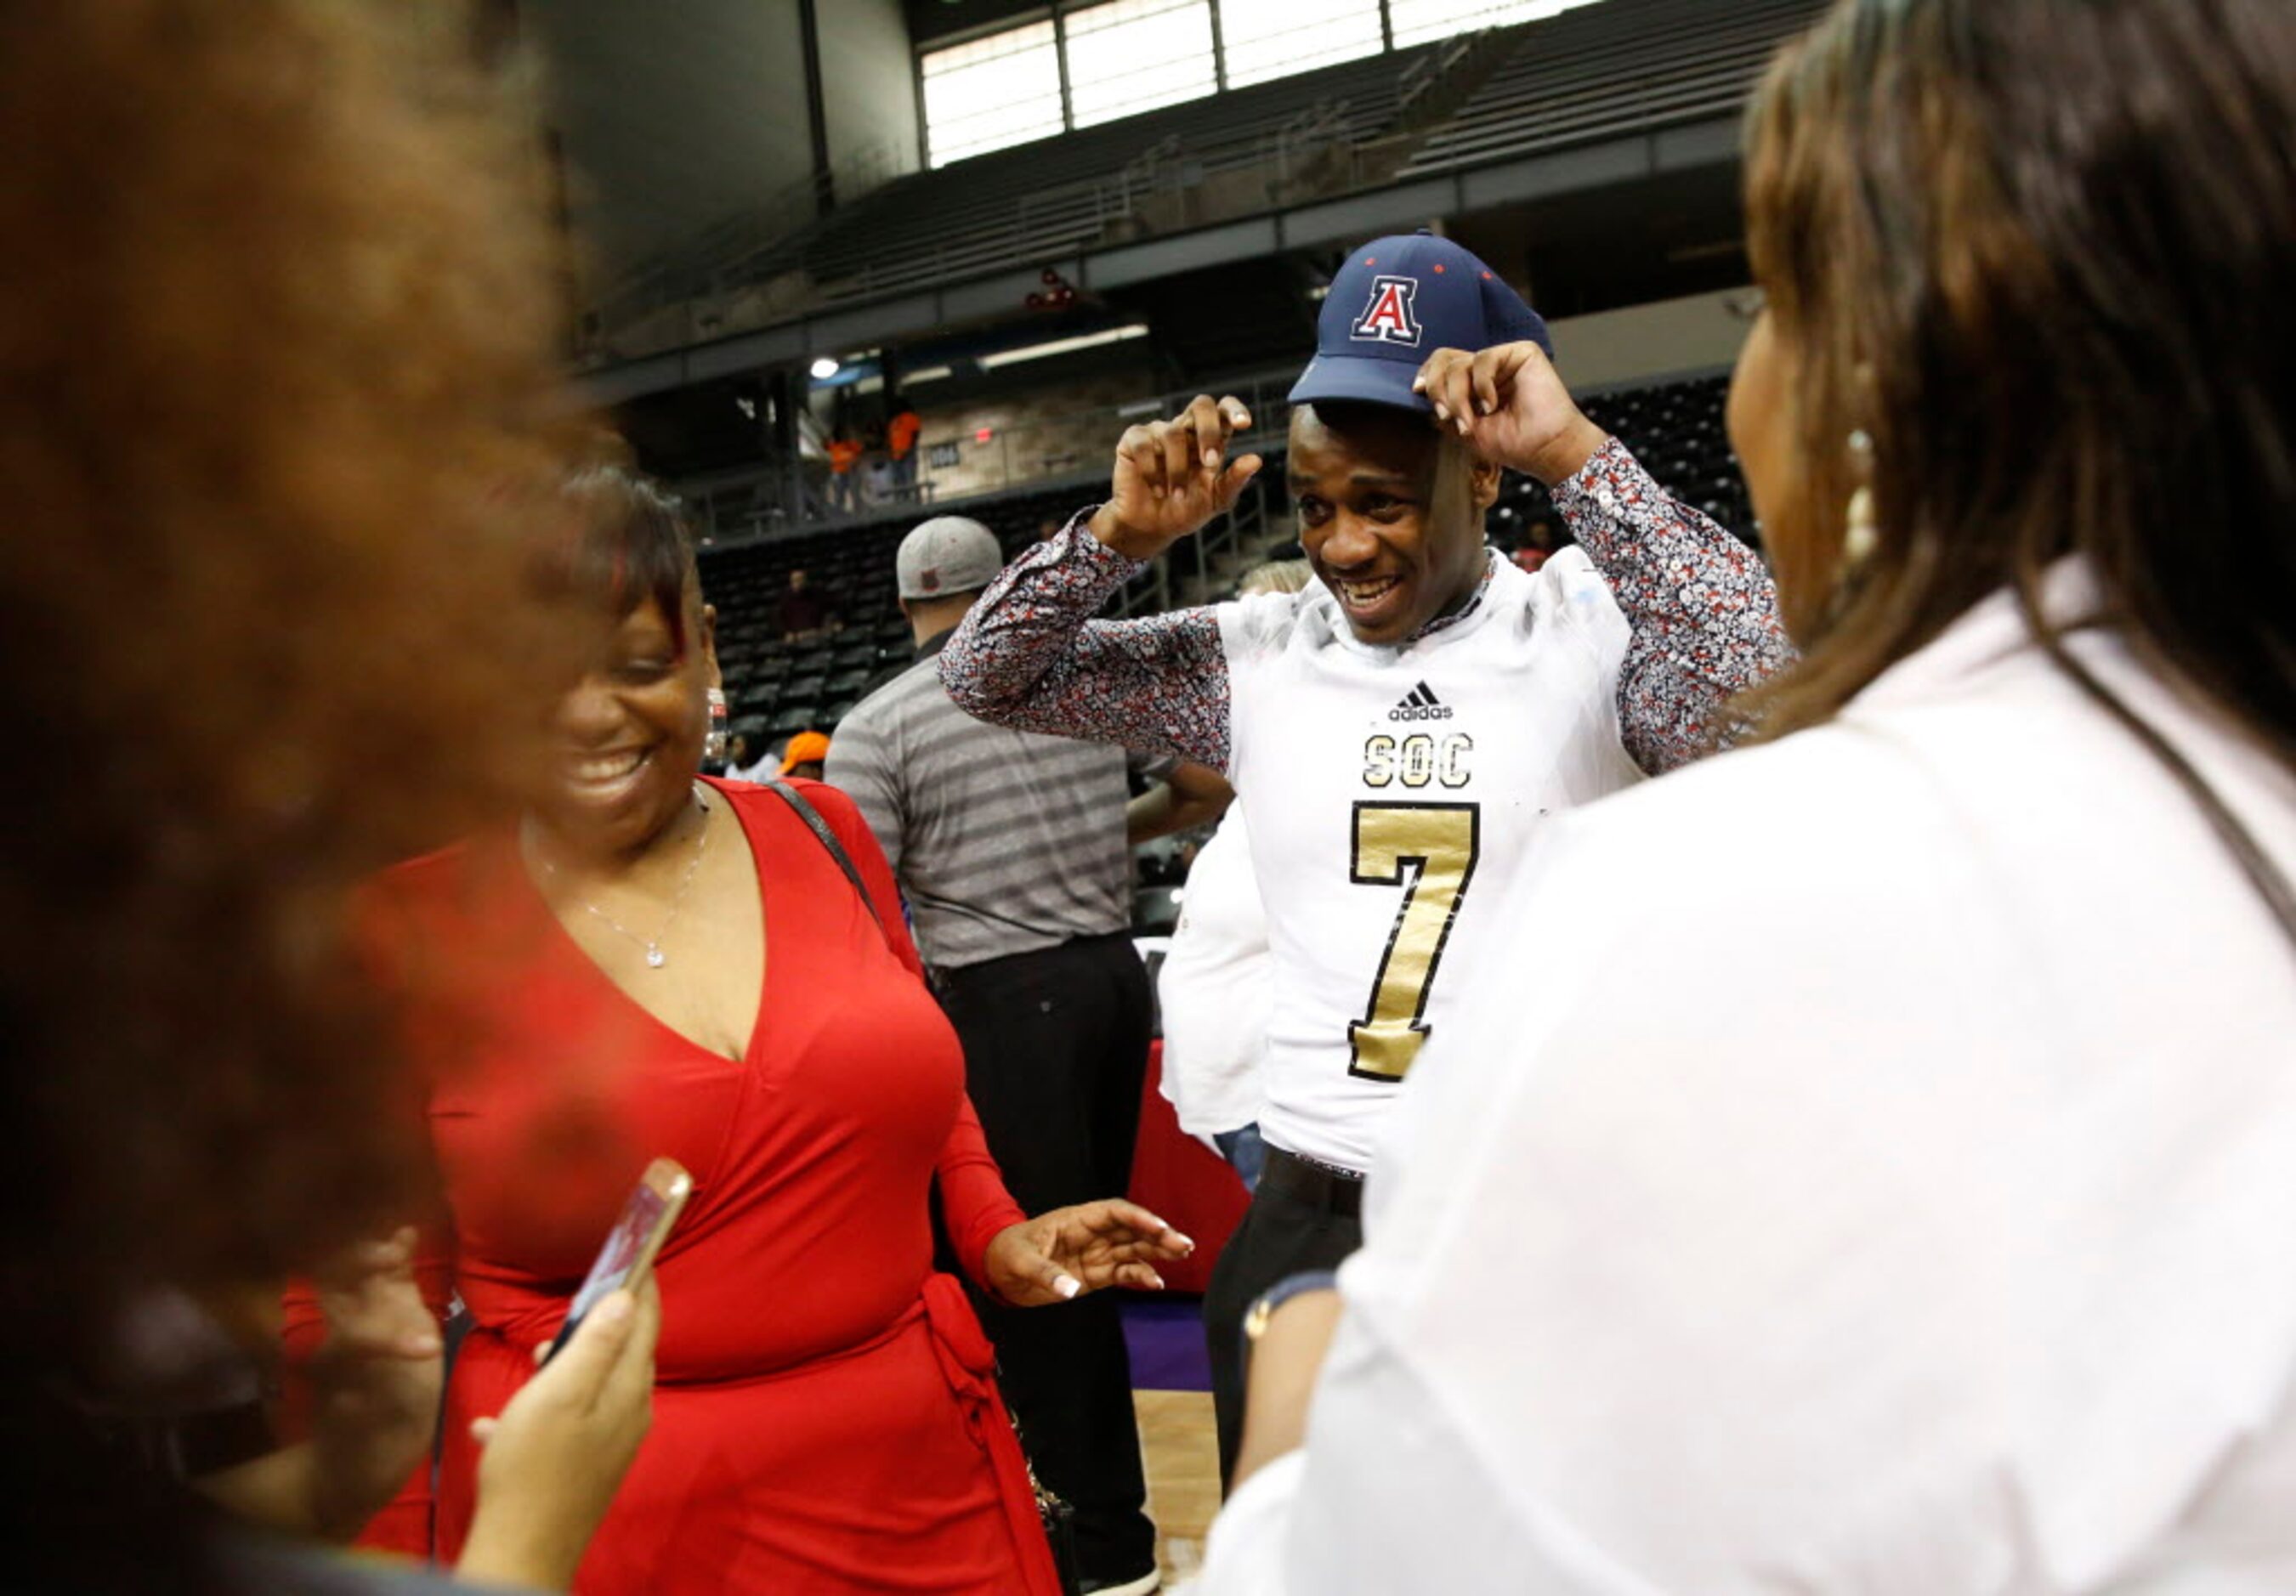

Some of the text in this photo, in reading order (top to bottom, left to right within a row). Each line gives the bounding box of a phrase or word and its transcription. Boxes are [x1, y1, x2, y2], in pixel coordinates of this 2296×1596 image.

[1350, 276, 1422, 348] A
[1389, 705, 1453, 722] adidas
[1363, 733, 1473, 788] SOC
[1348, 801, 1480, 1082] 7
